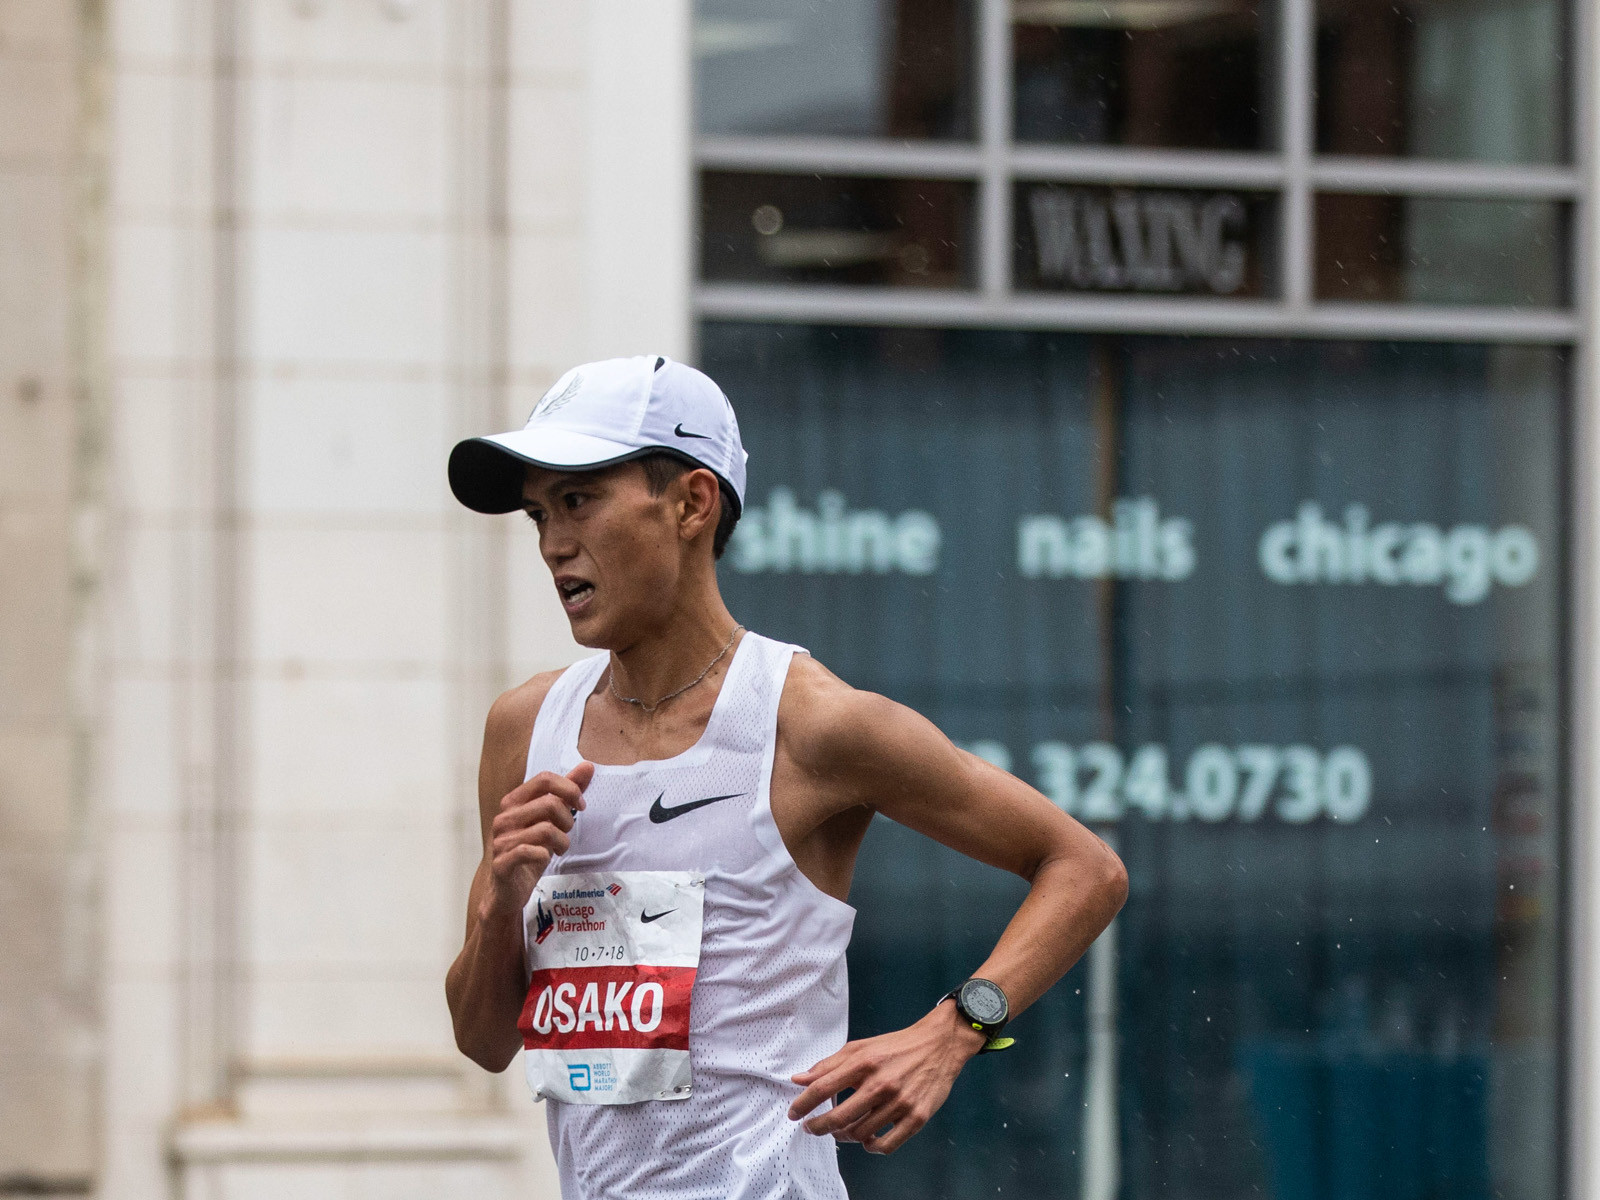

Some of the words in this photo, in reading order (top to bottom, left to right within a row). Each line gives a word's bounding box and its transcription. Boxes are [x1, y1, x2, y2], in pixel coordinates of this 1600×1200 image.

[731, 488, 941, 574] shine
[1018, 499, 1196, 580] nails
[1258, 500, 1538, 605] chicago
[962, 740, 1372, 823] 324.0730
[552, 890, 568, 899] Bank
[576, 889, 605, 898] America
[553, 904, 595, 919] Chicago
[557, 919, 605, 932] Marathon
[532, 980, 664, 1035] OSAKO
